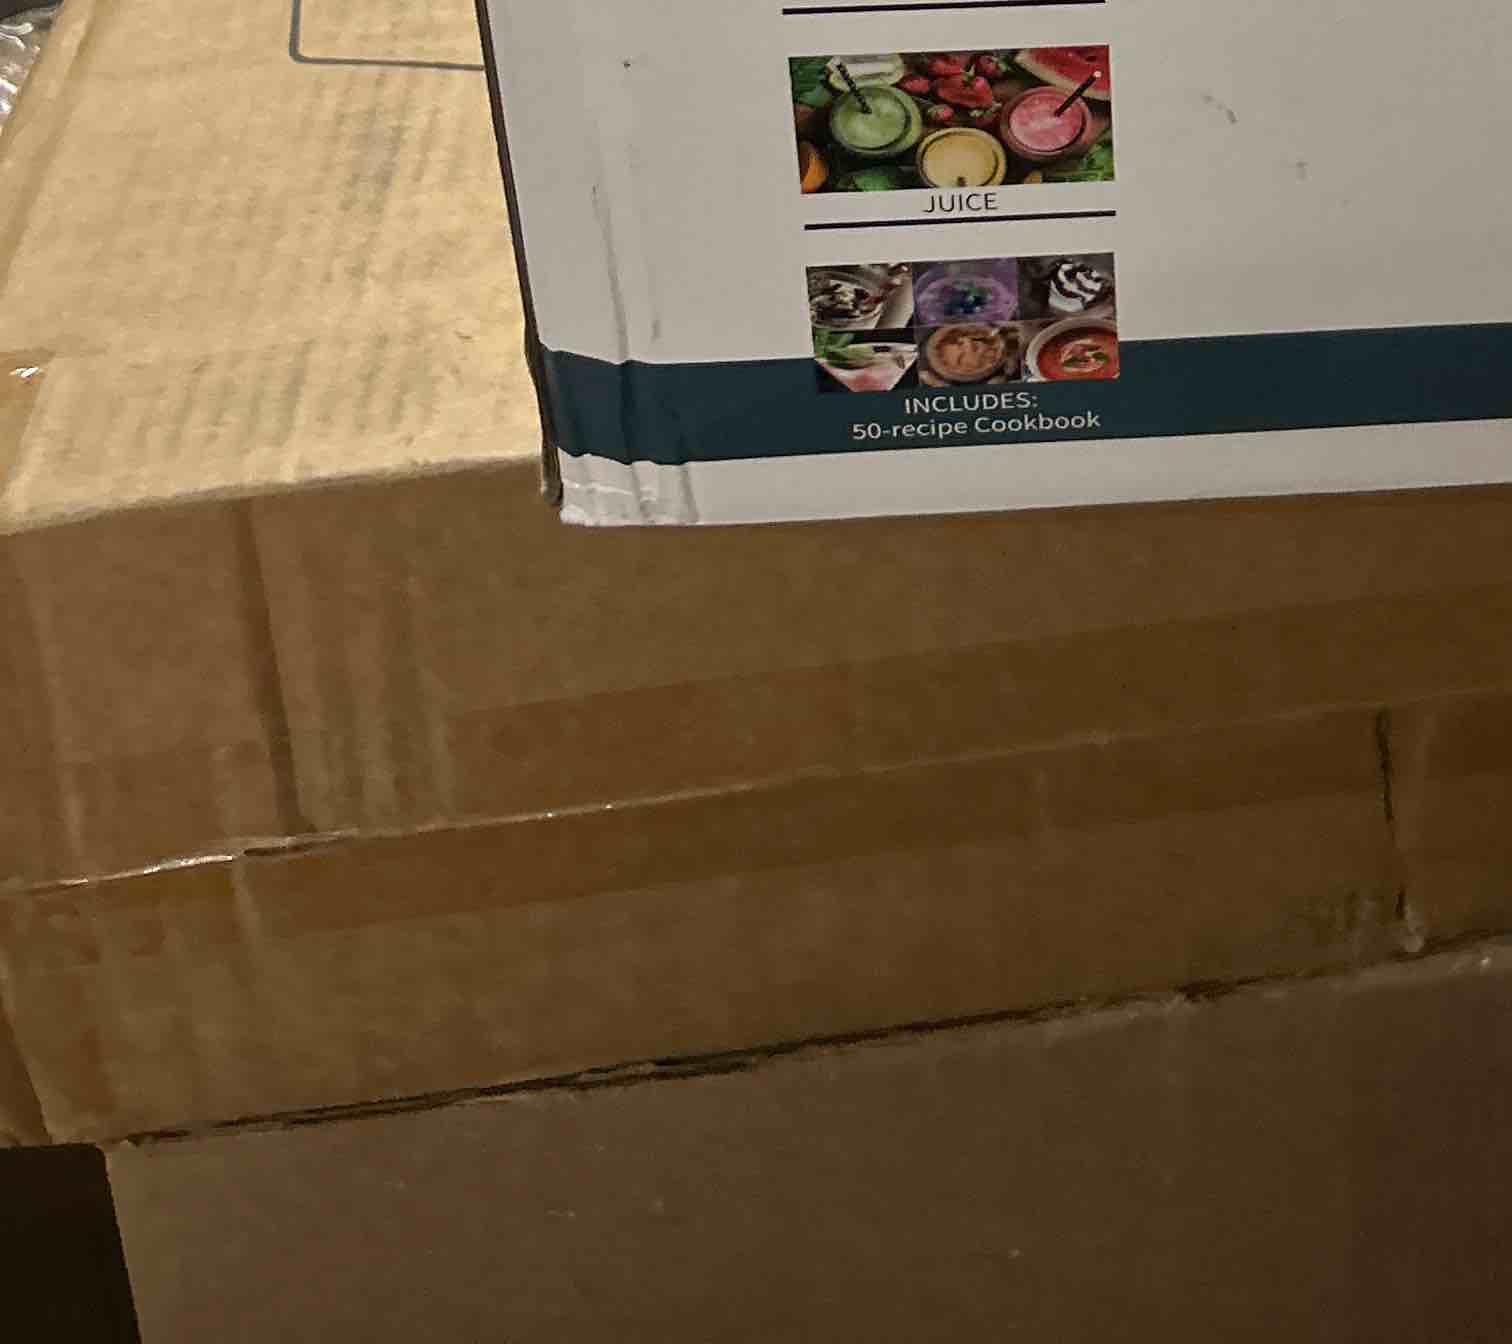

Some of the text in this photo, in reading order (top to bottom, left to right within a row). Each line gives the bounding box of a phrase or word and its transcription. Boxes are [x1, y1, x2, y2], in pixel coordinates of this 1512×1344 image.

[922, 192, 999, 214] JUICE
[904, 391, 1039, 415] INCLUDES:
[852, 411, 1101, 441] 50-recipe Cookbook
